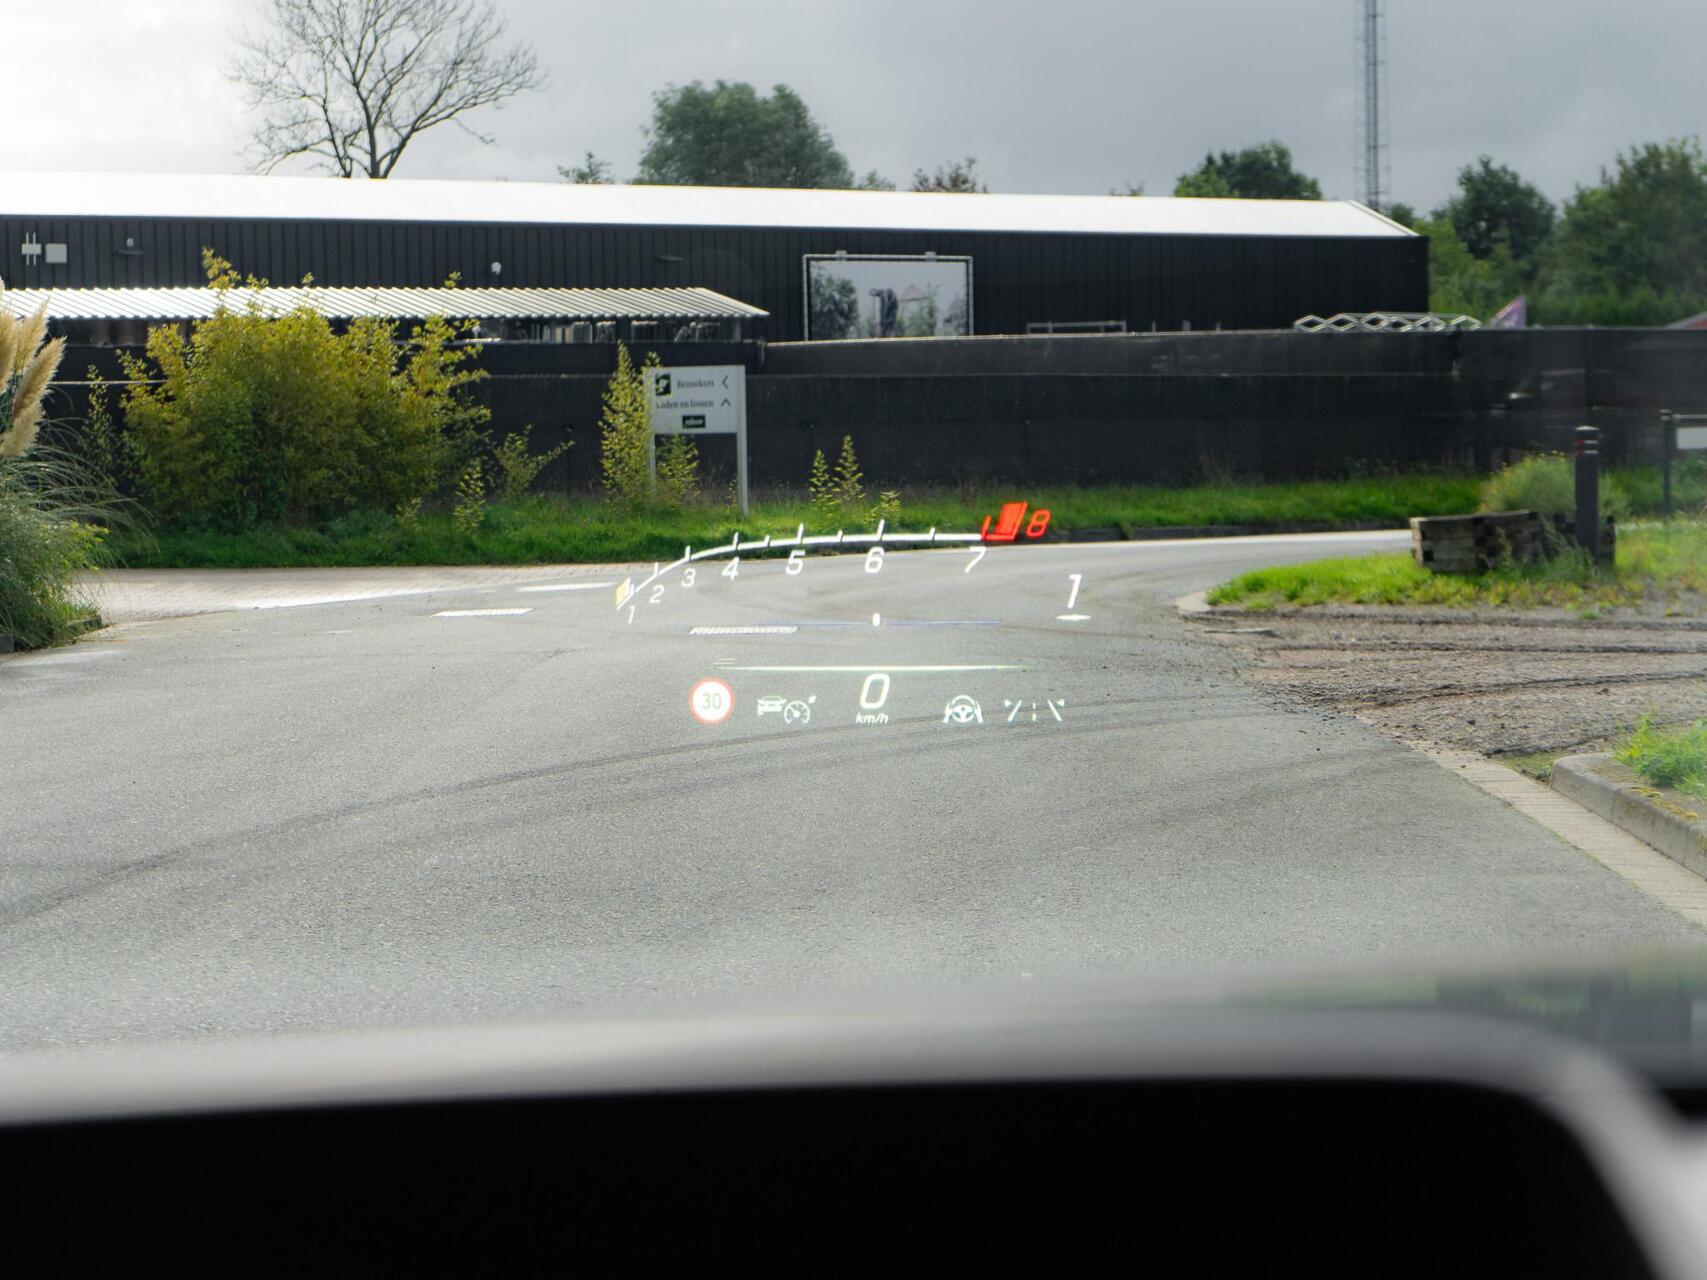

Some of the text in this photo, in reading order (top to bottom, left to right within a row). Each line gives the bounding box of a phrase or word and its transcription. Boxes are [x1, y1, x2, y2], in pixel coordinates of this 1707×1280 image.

[628, 509, 1050, 624] 1 2 3 4 5 6 7 8
[1067, 574, 1082, 609] 1
[702, 692, 722, 709] 30
[859, 673, 890, 709] 0
[855, 712, 889, 724] km/h
